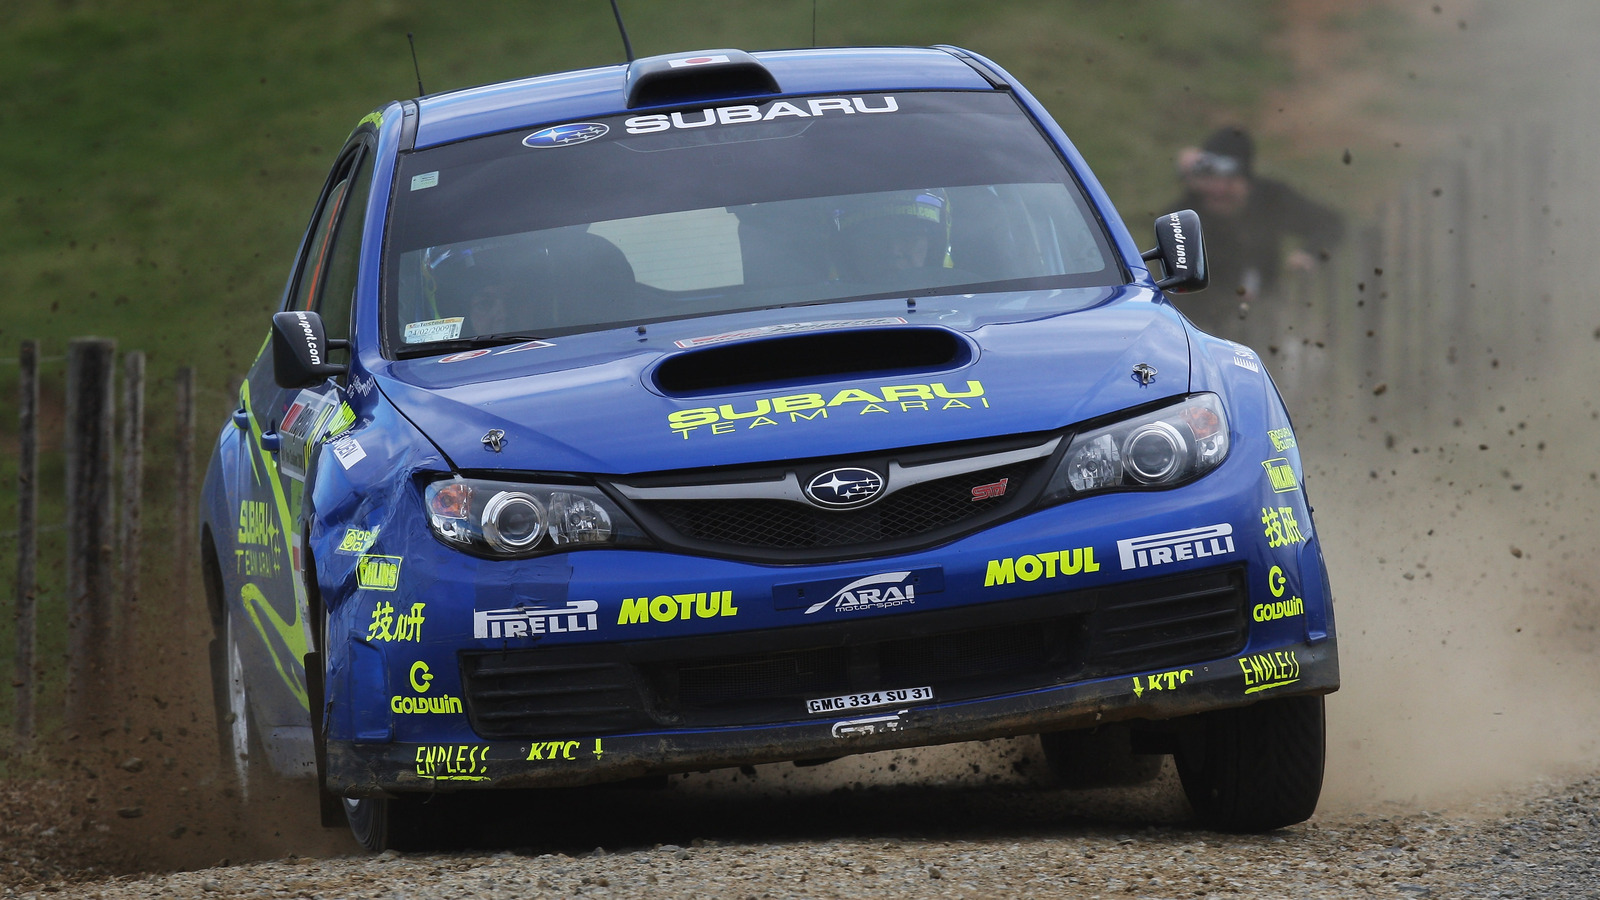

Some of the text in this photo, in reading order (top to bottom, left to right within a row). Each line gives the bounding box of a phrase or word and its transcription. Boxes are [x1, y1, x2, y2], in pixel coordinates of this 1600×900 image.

[624, 96, 899, 134] SUBARU
[667, 380, 985, 429] SUBARU
[672, 397, 990, 440] TEAM ARAI
[1116, 522, 1236, 571] PIRELLI
[984, 546, 1100, 587] MOTUL
[617, 590, 738, 625] MOTUL
[835, 584, 915, 607] ARAI
[835, 598, 916, 613] motorsport
[473, 600, 599, 639] PIRELLI
[1147, 669, 1194, 691] KTC
[1238, 651, 1300, 686] ENDLESS
[809, 687, 932, 712] GMG 334 SU 31
[415, 745, 490, 775] ENDLESS
[526, 740, 580, 761] KTC
